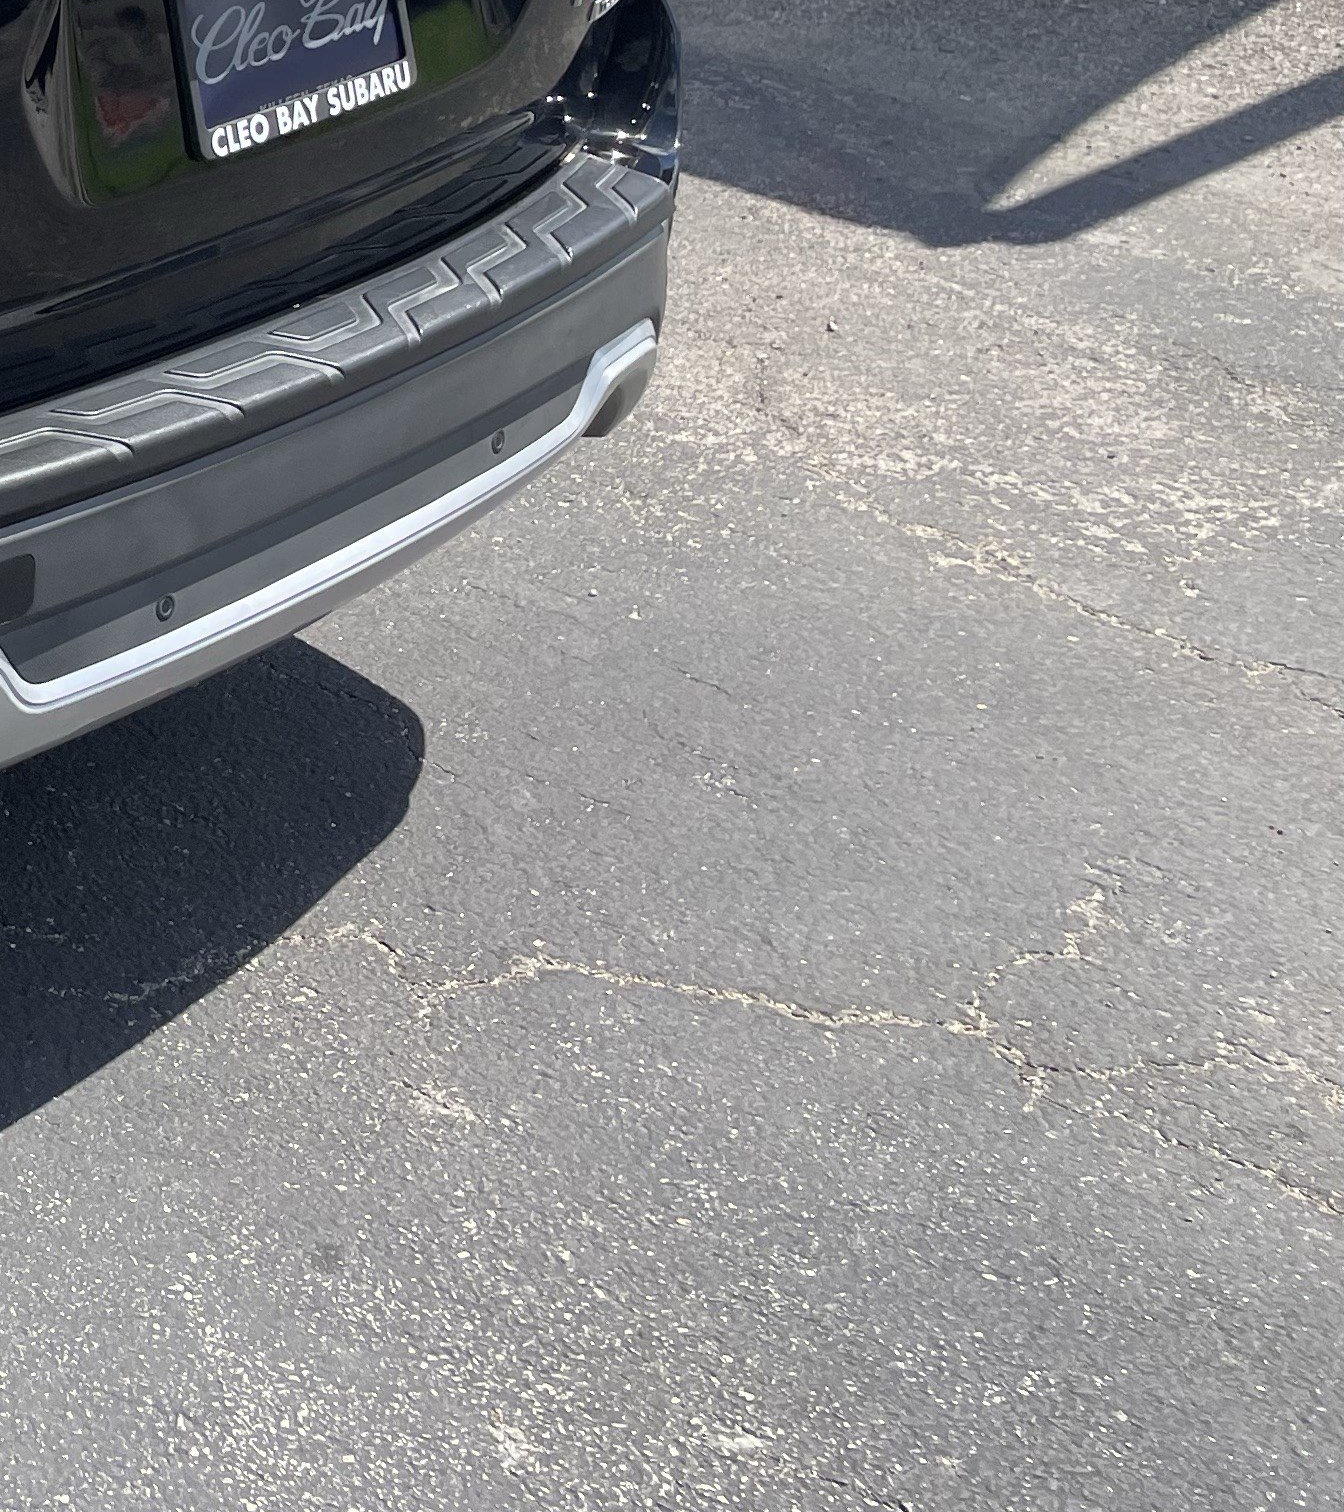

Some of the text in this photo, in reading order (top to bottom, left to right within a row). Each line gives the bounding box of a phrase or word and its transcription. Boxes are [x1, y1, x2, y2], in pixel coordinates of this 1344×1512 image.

[191, 1, 300, 85] Cleo
[211, 113, 270, 157] CLEO
[275, 93, 319, 135] BAY
[327, 60, 411, 116] SUBARU
